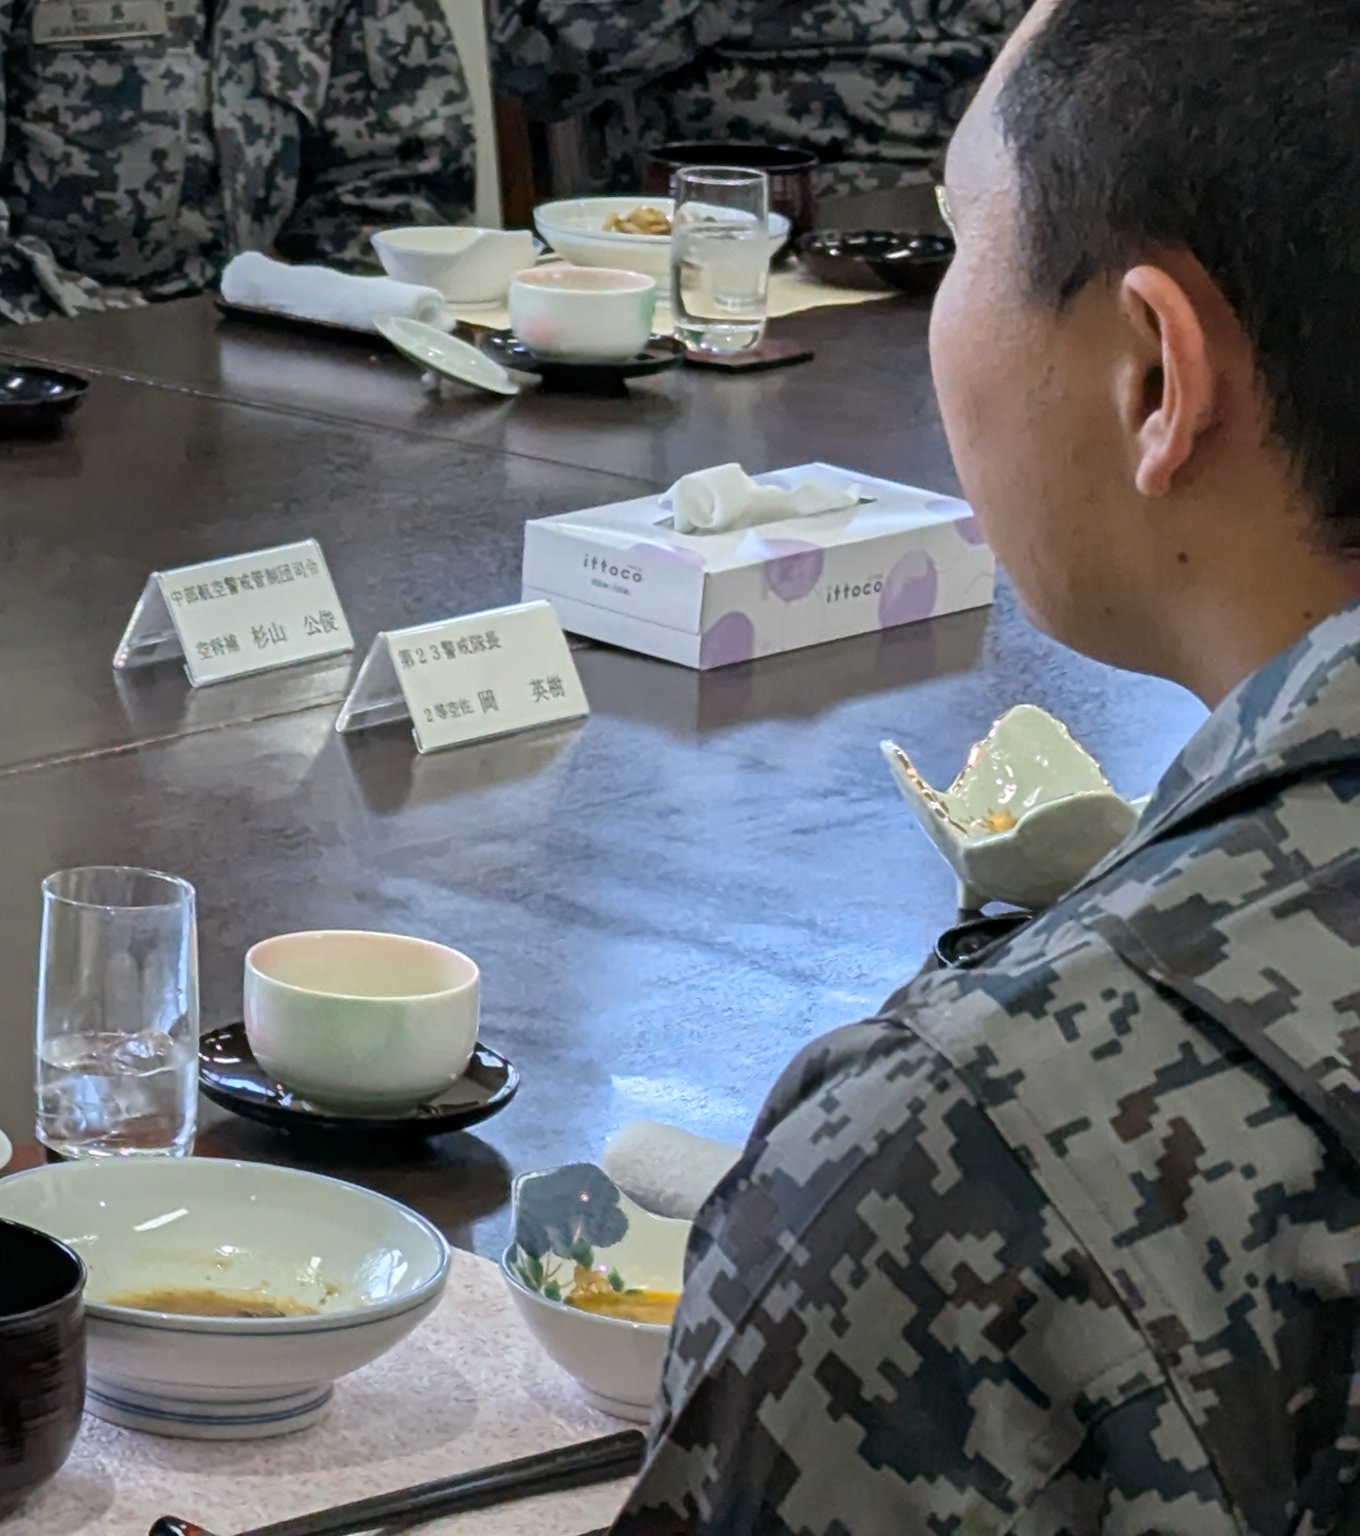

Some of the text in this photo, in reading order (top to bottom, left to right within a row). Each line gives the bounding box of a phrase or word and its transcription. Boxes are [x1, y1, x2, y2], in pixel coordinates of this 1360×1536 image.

[583, 553, 643, 583] ittoco
[826, 578, 883, 604] ittoco
[251, 621, 289, 650] 杉山
[477, 688, 500, 715] 岡
